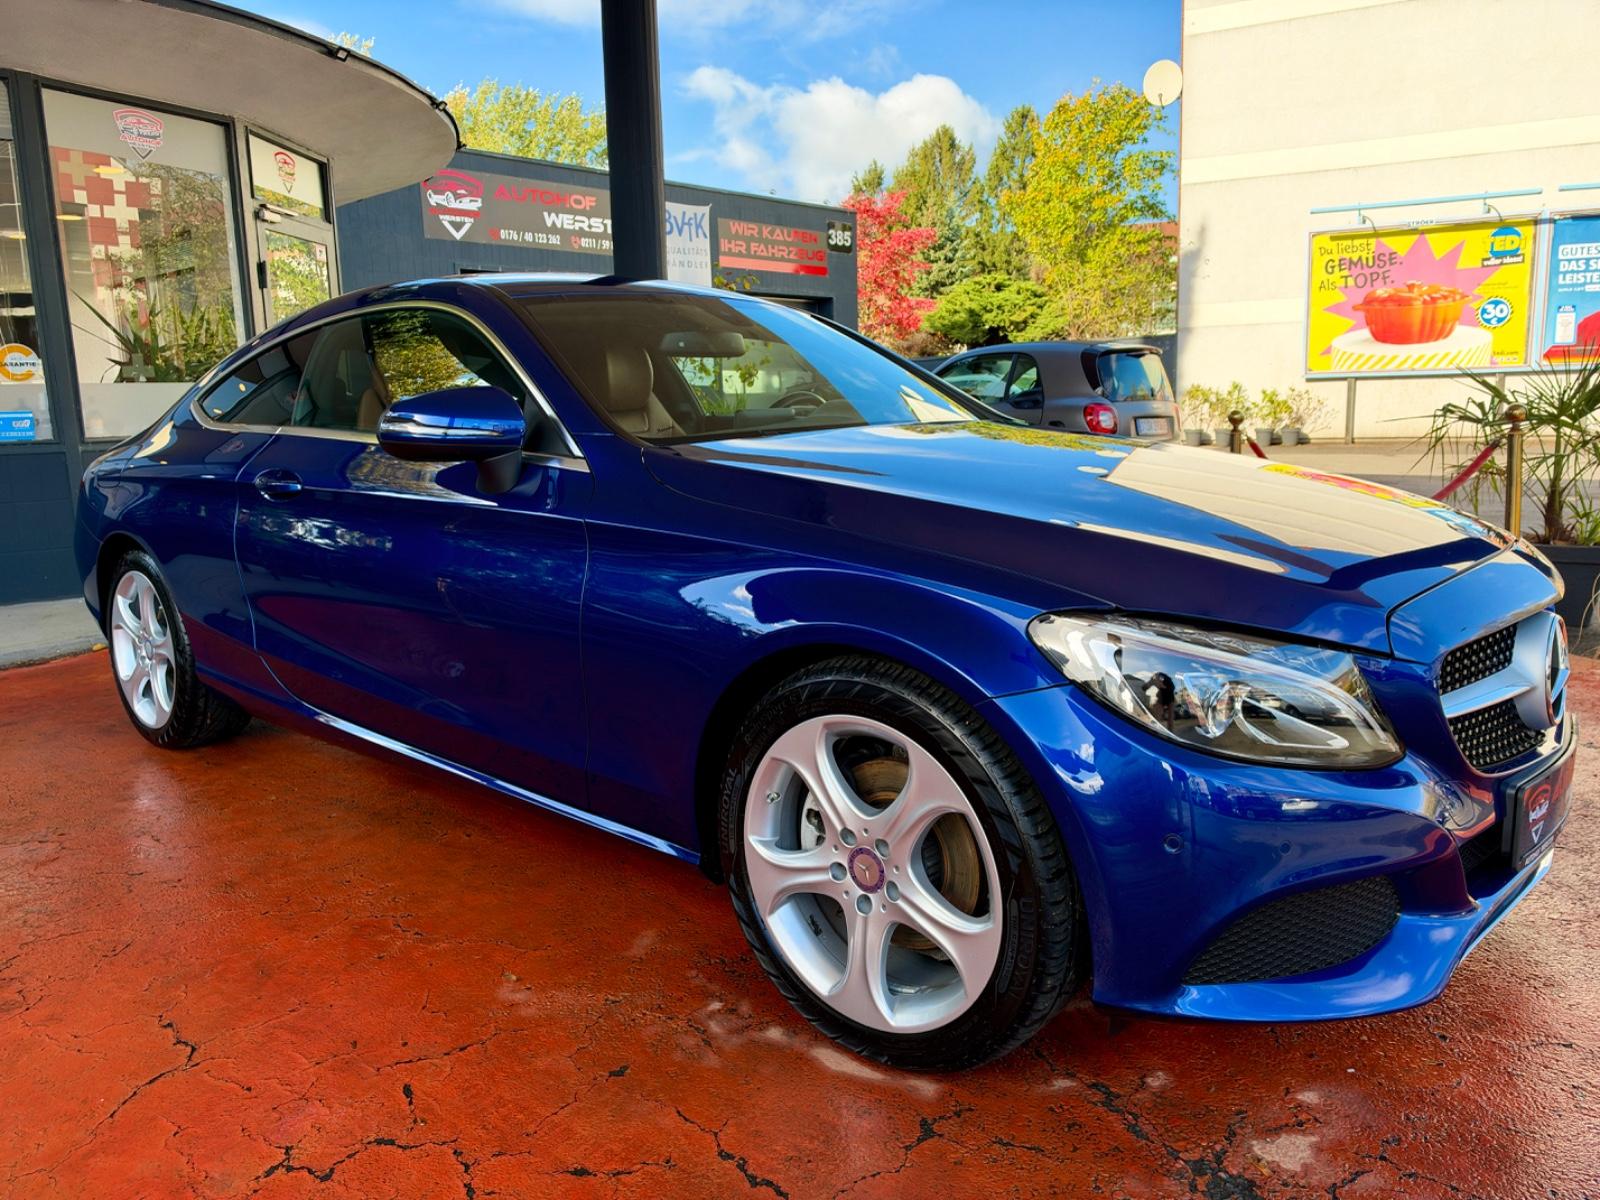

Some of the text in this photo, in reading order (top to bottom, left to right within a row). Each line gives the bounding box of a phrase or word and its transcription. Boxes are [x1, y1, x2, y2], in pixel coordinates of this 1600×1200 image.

[494, 184, 597, 210] AUTOHOF
[543, 211, 612, 234] WERST
[500, 229, 518, 241] 0176
[524, 232, 533, 242] 40
[534, 233, 547, 243] 123
[548, 234, 561, 245] 262
[730, 220, 819, 244] WIR KAUFEN
[828, 230, 851, 246] 385
[580, 237, 596, 248] 0211
[720, 238, 827, 262] IHR FAHRZEUG
[1319, 239, 1372, 256] Du liebst
[1561, 246, 1600, 257] GUTES
[1325, 251, 1403, 275] GEMÜSE.
[1559, 258, 1600, 271] DAS S
[1319, 269, 1394, 293] Als TOPF.
[1483, 304, 1508, 319] 30
